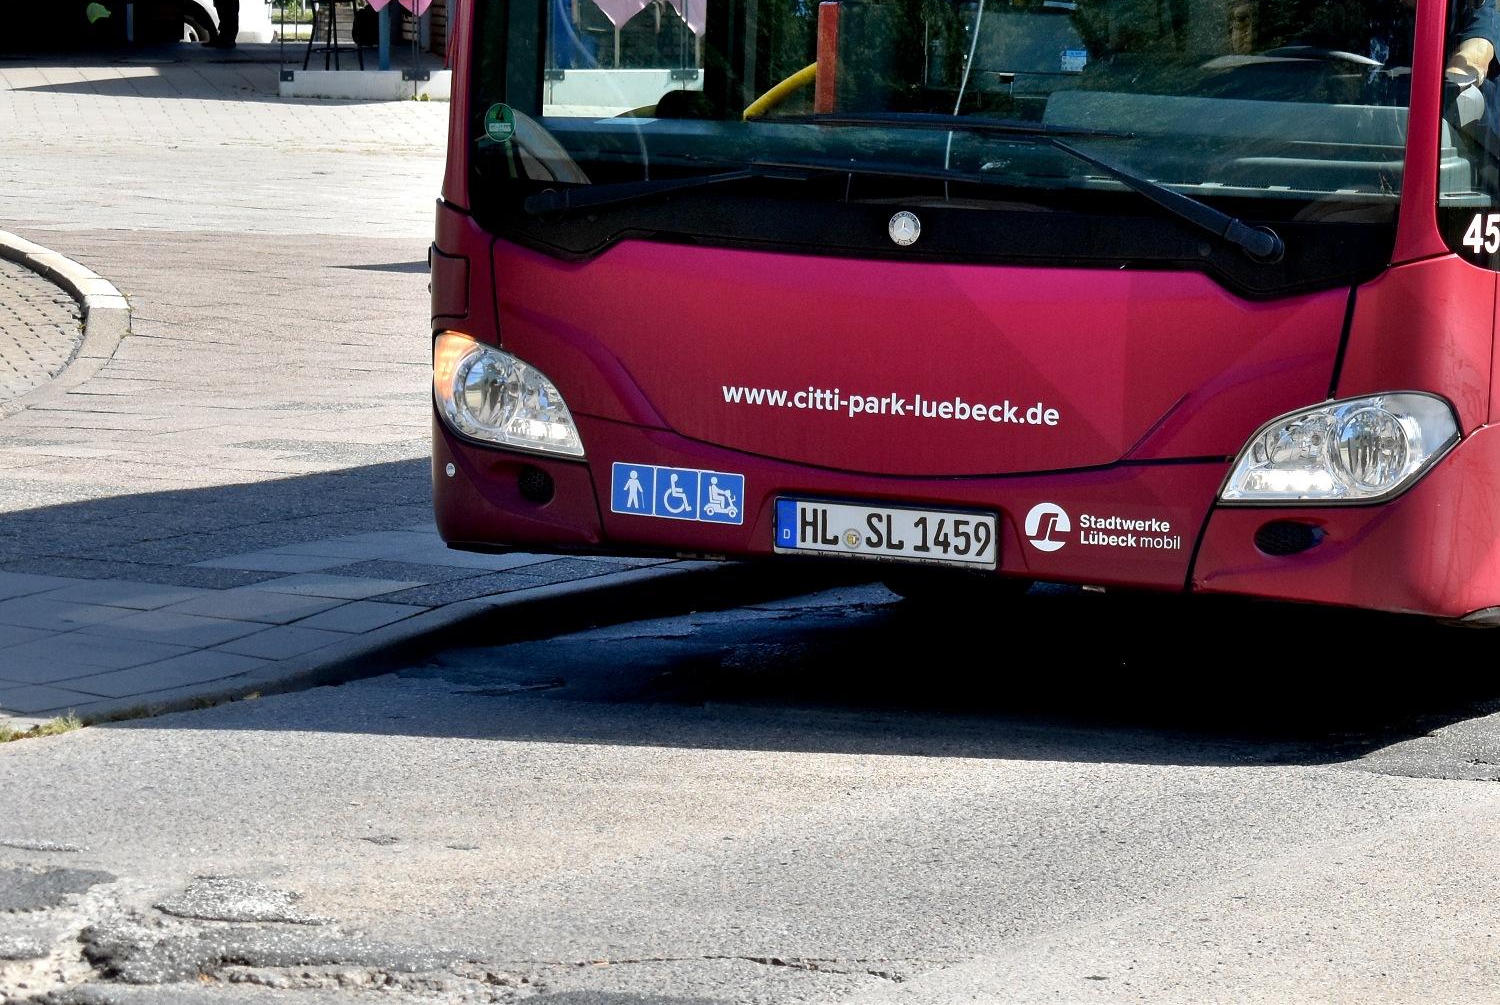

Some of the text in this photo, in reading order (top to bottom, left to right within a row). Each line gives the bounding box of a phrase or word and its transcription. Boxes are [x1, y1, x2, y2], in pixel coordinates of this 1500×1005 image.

[722, 385, 1060, 426] www.citti-park-luebeck.de
[800, 507, 992, 557] HL SL 1459
[1079, 514, 1170, 532] Stadtwerke
[783, 528, 791, 539] D
[1080, 530, 1181, 550] Lübeck mobil
